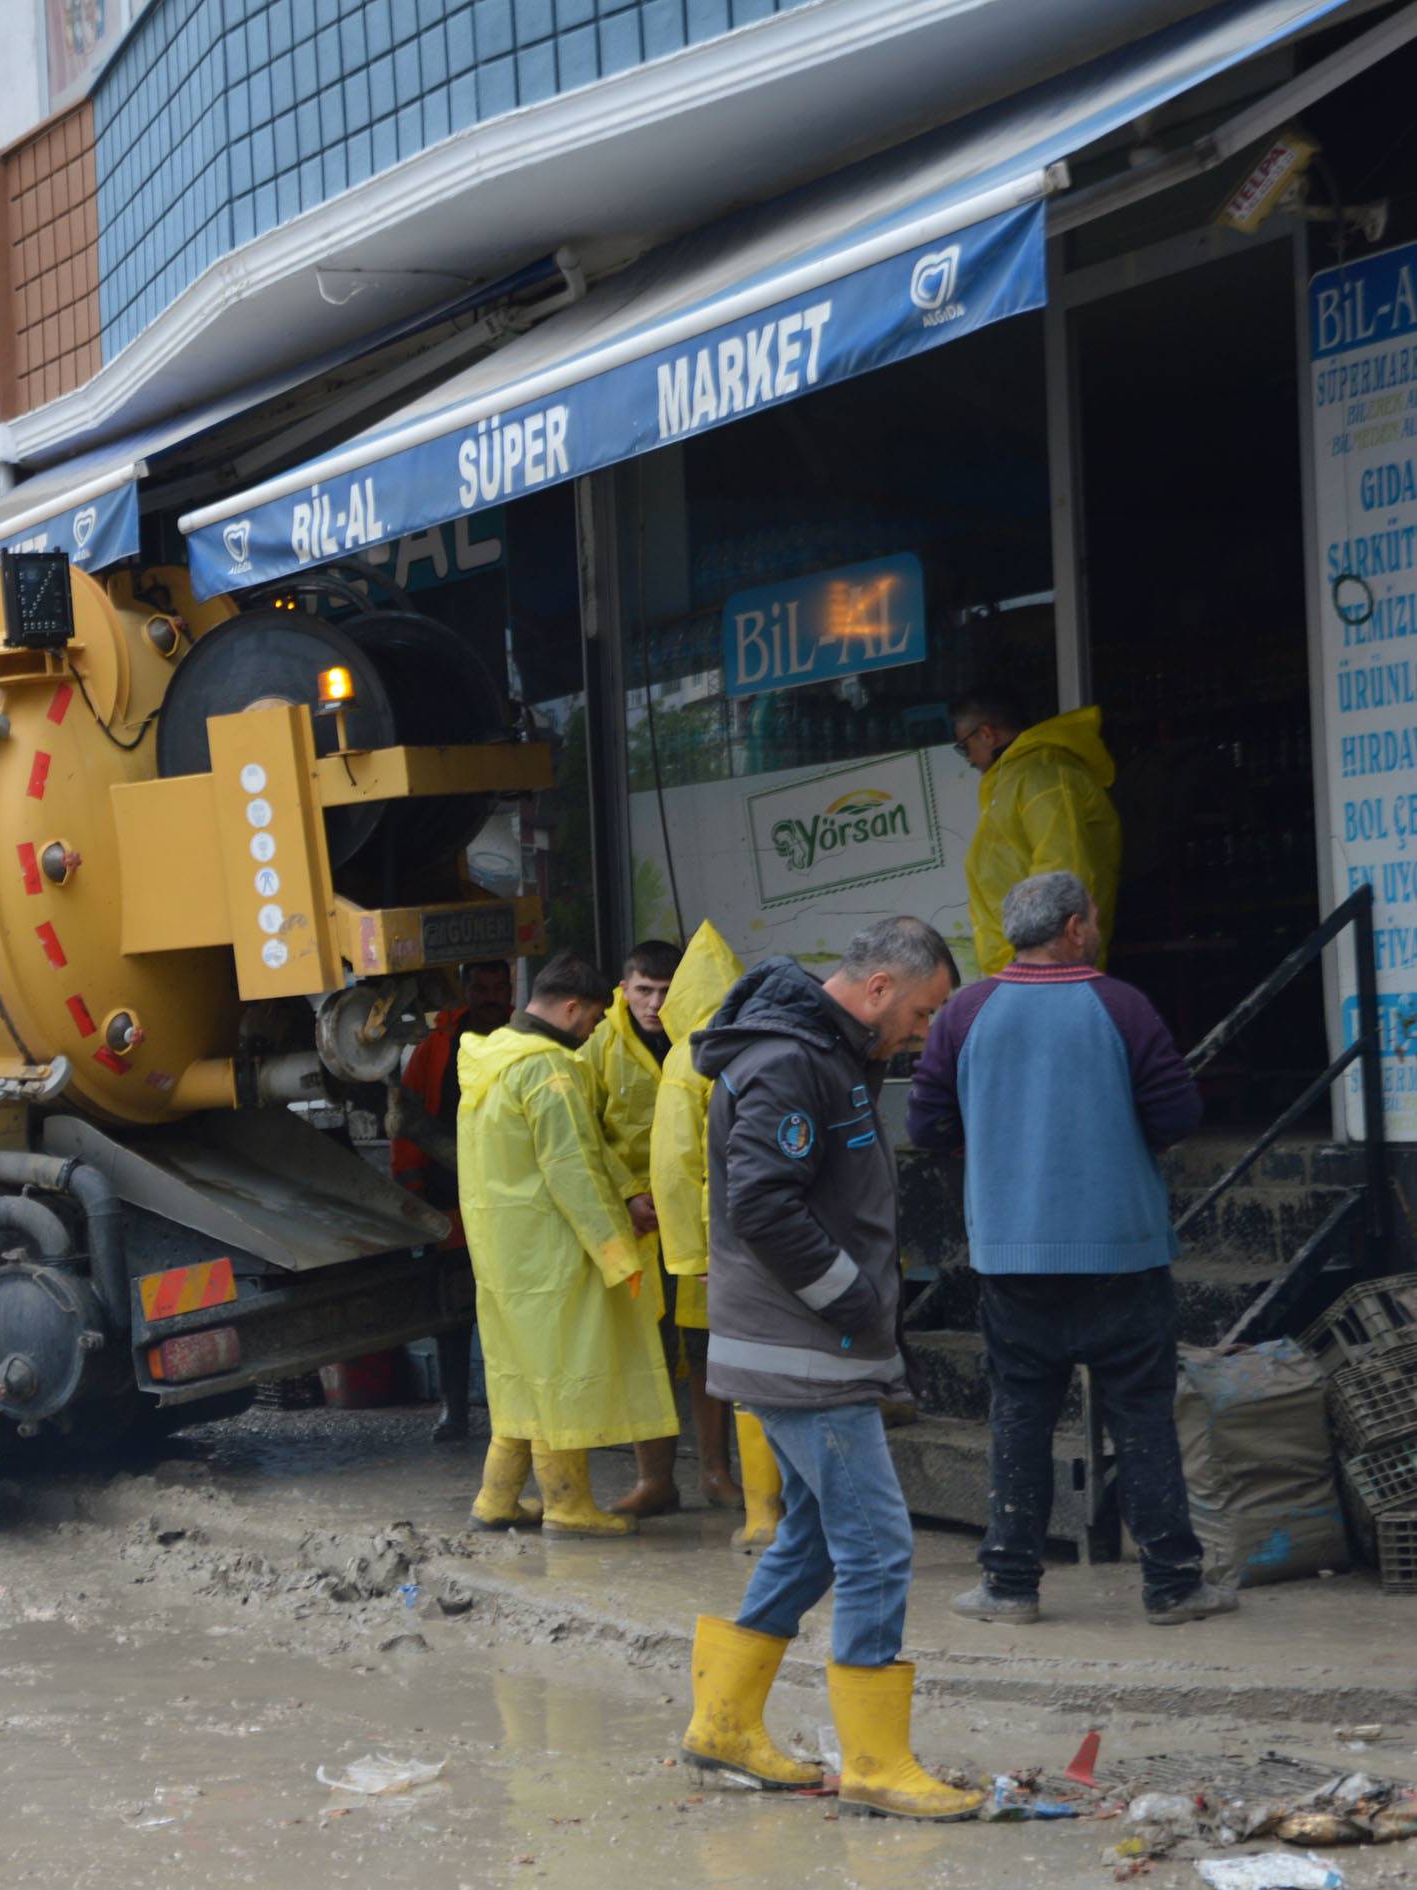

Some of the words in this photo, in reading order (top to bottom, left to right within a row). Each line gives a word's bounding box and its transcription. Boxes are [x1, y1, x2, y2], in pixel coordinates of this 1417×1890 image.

[922, 303, 967, 328] ALGIDA
[1317, 348, 1417, 407] SÜPERMAR
[291, 477, 383, 564] BİL-AL
[458, 405, 570, 509] SÜPER
[657, 299, 833, 440] MARKET
[793, 803, 910, 868] Yörsan
[1343, 798, 1388, 843] BOL
[1383, 862, 1417, 904] UY
